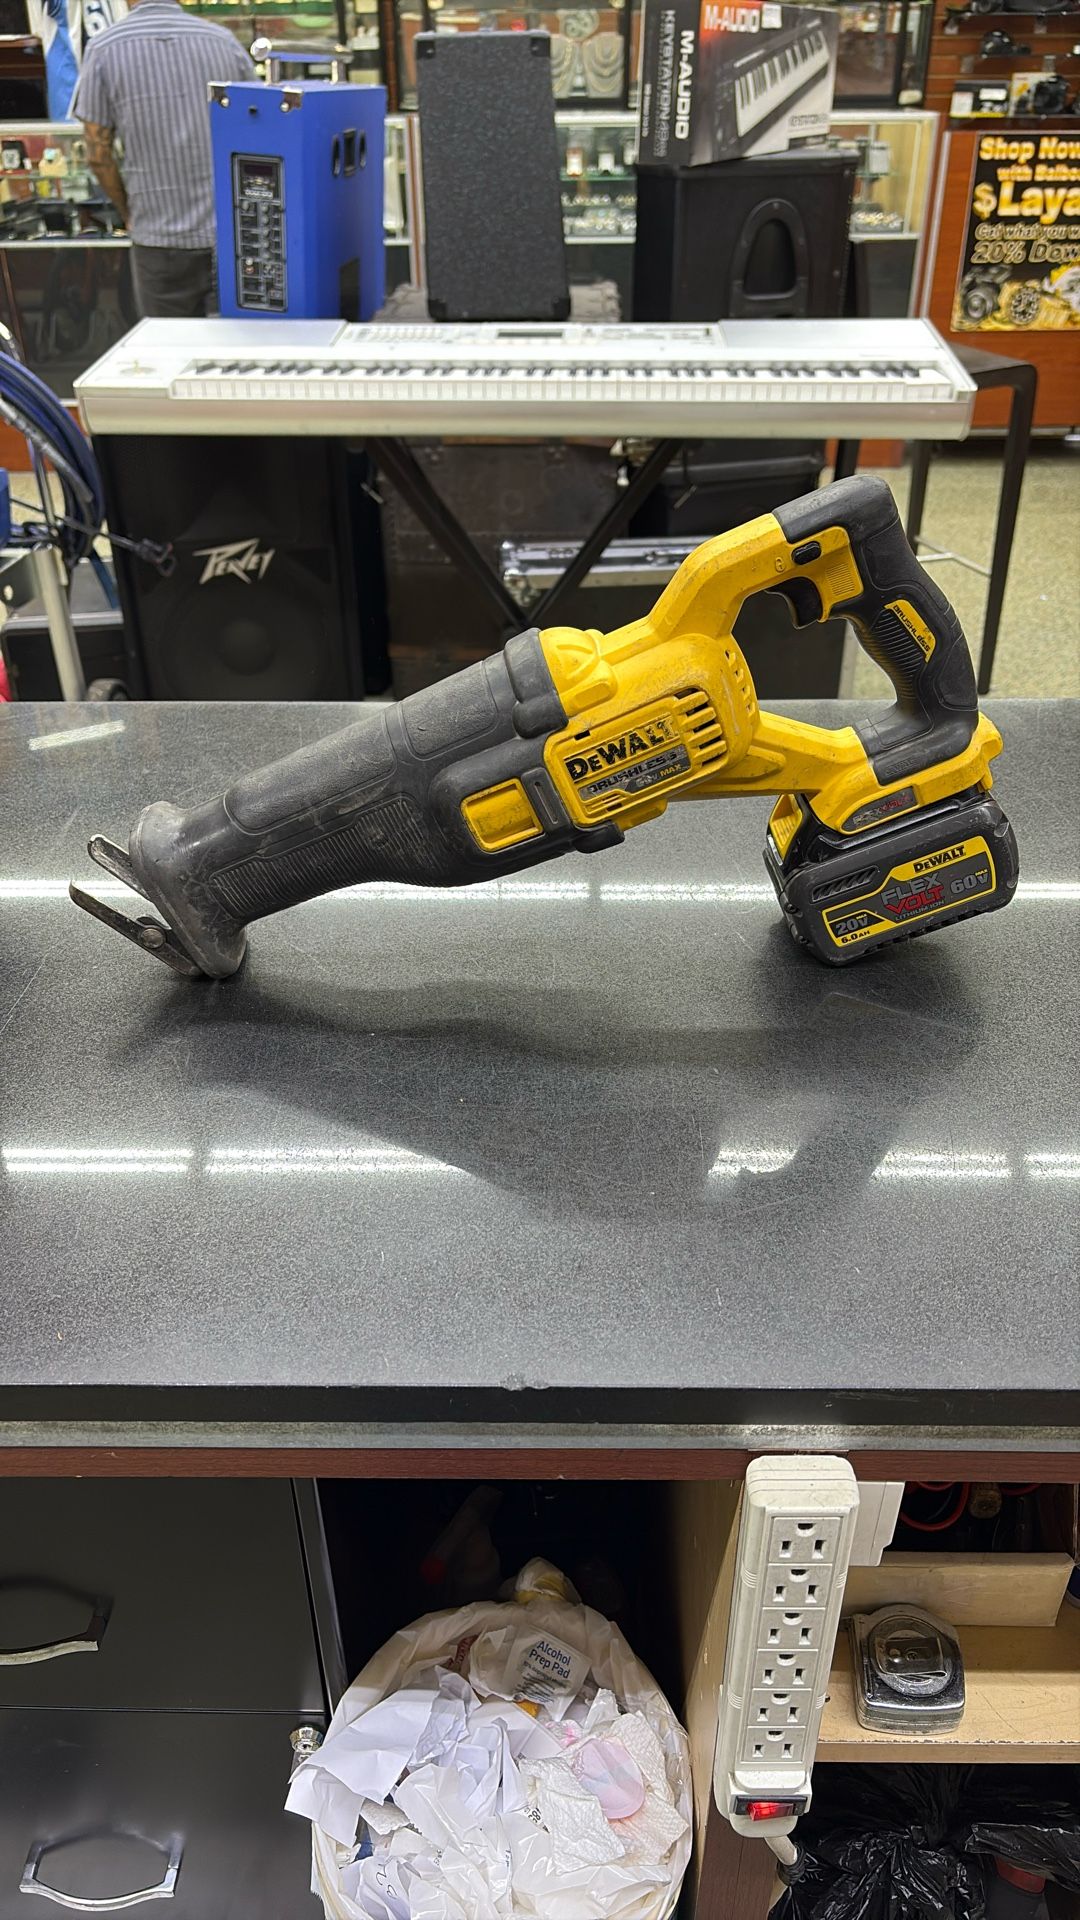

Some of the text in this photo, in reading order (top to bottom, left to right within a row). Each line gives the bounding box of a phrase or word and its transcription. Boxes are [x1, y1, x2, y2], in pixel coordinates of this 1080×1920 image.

[703, 4, 760, 33] M-AUDIO
[659, 9, 676, 121] KEYSTATION
[674, 30, 695, 140] M-AUDIO
[979, 136, 1035, 164] Shop
[997, 164, 1033, 181] with
[1003, 222, 1040, 240] what
[971, 241, 1026, 263] 20%
[892, 604, 931, 652] BRUSHLESS
[659, 763, 682, 778] MAX
[912, 845, 967, 873] DEWALT
[880, 872, 942, 904] FLEX
[885, 885, 945, 914] VOLT
[528, 1648, 551, 1669] Prep
[551, 1661, 571, 1679] Pad
[536, 1640, 571, 1666] Alcohol
